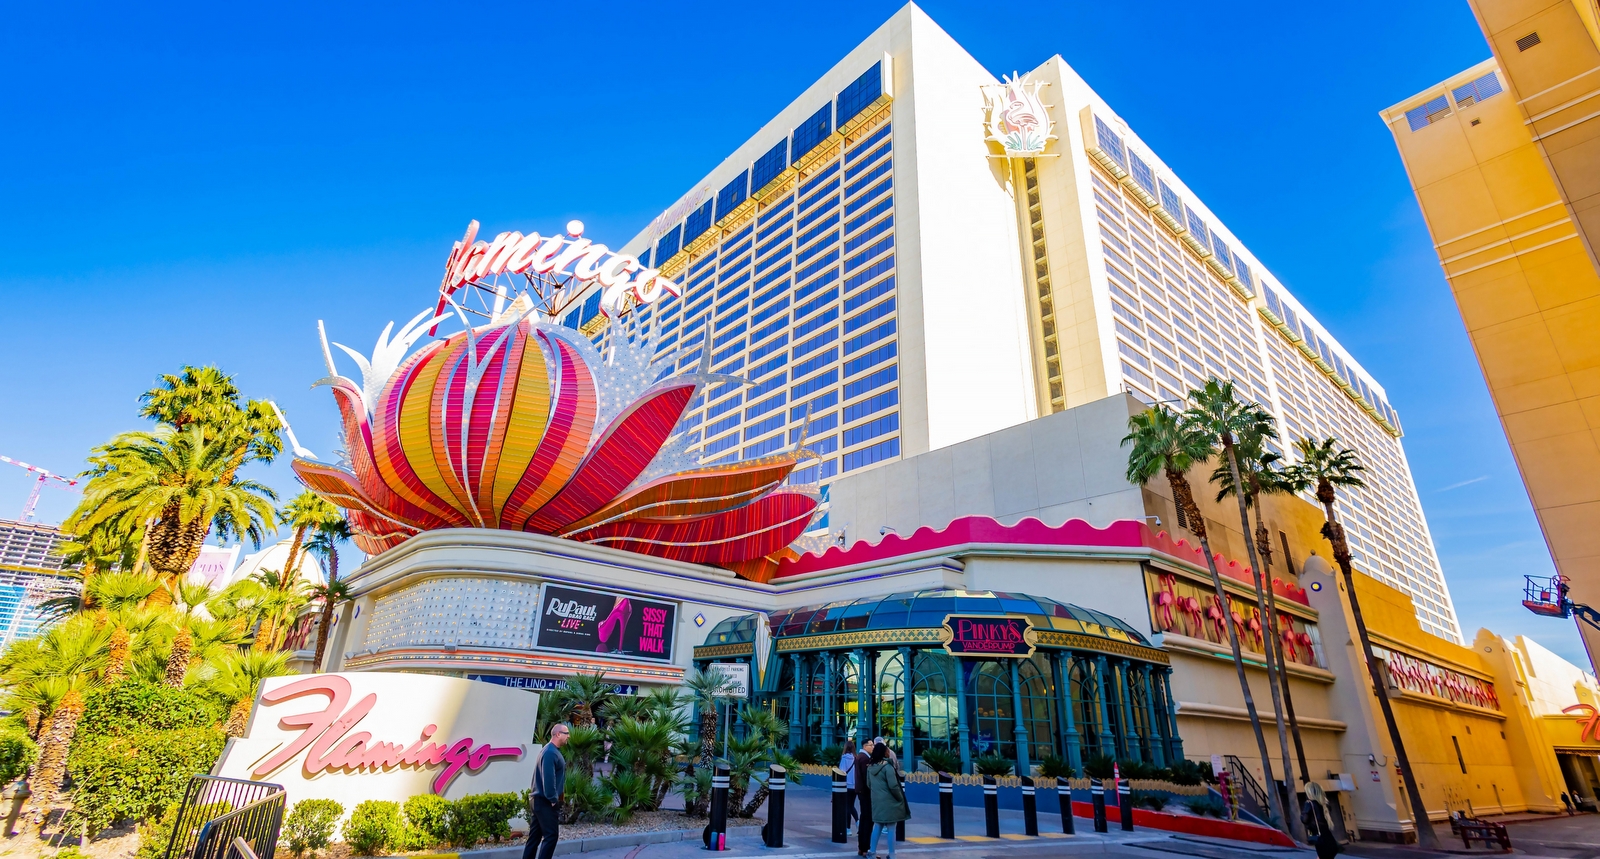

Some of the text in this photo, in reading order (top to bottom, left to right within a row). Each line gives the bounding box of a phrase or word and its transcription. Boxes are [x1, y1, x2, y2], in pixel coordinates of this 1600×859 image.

[643, 607, 667, 623] SISSY
[561, 618, 581, 629] LIVE
[643, 622, 664, 638] THAT
[957, 619, 1022, 642] PINKY'S
[640, 637, 664, 653] WALK
[962, 641, 1015, 650] VANDERPUMP
[505, 677, 523, 688] THE
[525, 678, 546, 689] LINQ
[555, 680, 577, 691] HIG
[253, 675, 522, 794] Flamingo
